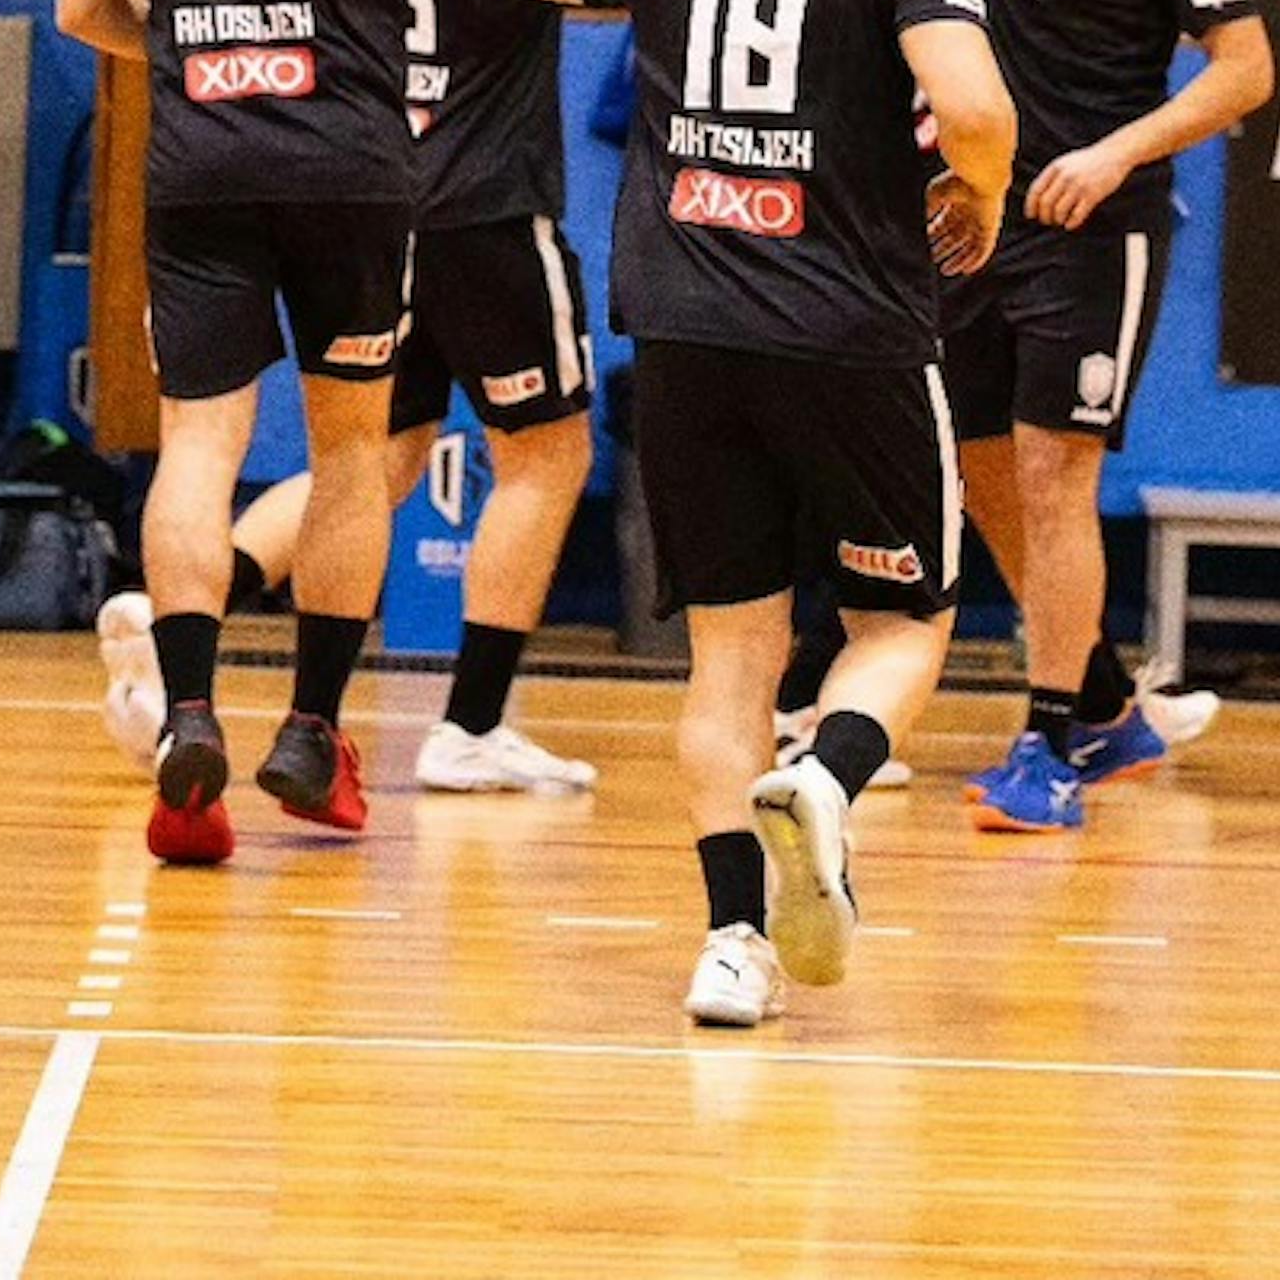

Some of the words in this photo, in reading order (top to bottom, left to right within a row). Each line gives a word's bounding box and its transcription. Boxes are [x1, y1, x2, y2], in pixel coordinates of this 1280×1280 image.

[173, 5, 214, 44] RK
[215, 2, 314, 43] OSIJEK
[197, 54, 305, 94] XIXO
[680, 177, 795, 229] XIXO
